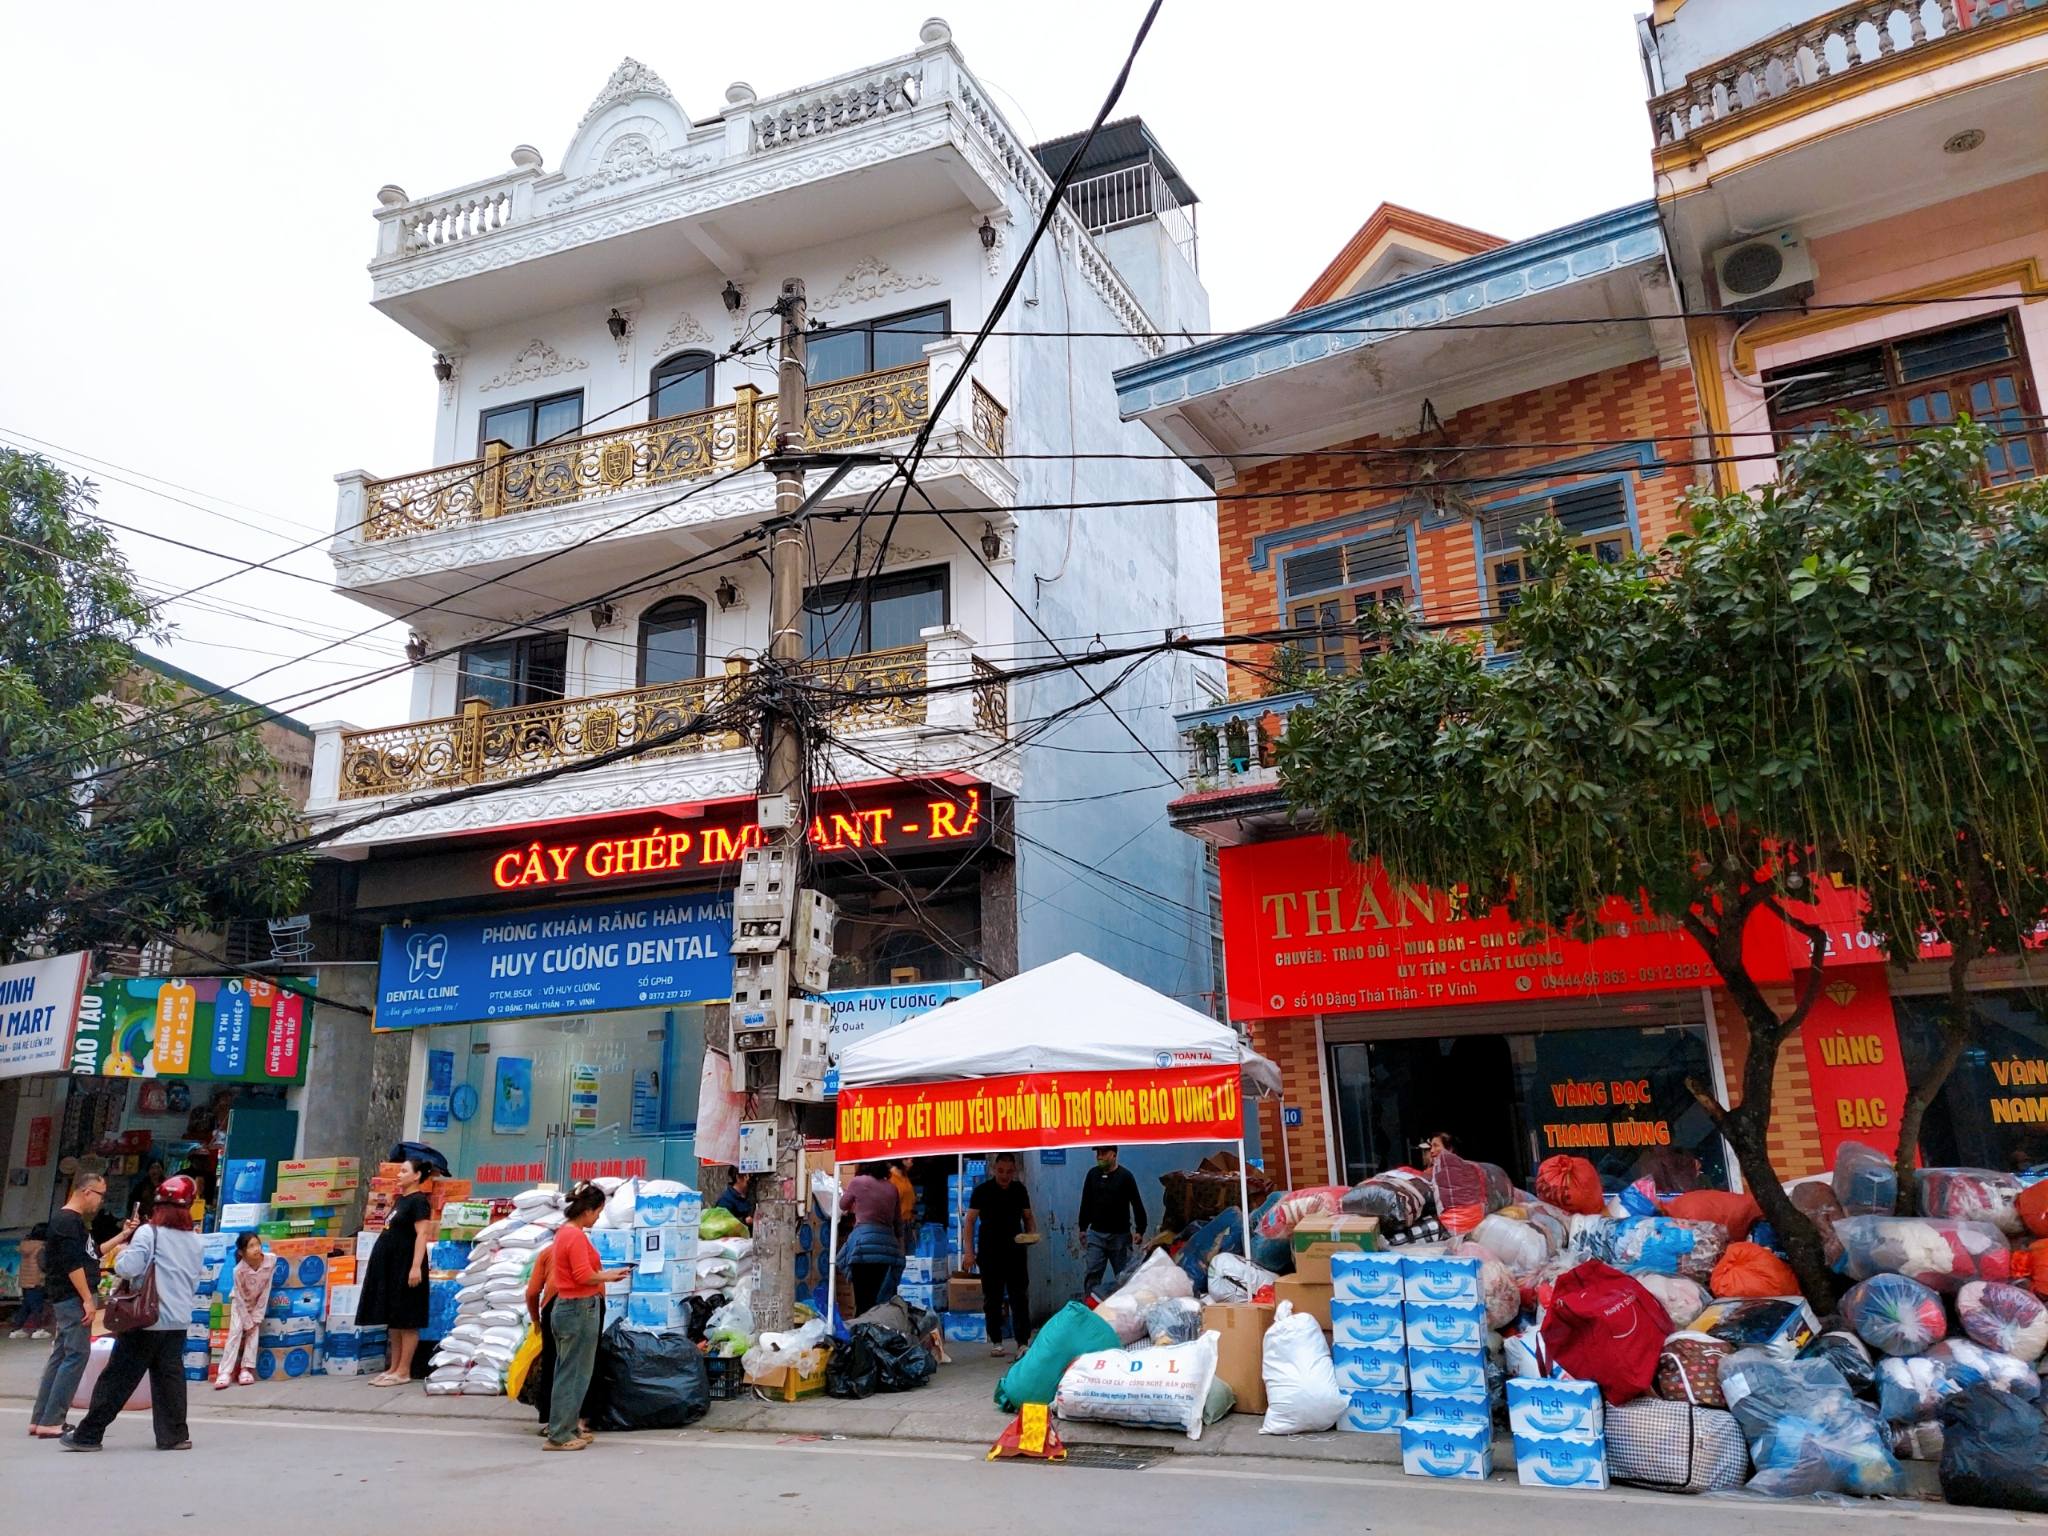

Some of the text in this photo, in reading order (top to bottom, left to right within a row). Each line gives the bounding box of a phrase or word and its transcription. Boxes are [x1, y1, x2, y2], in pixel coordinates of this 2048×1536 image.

[493, 841, 578, 889] CÂY
[585, 825, 691, 878] GHÉP
[482, 921, 536, 944] PHÒNG
[542, 914, 592, 938] KHÁM
[599, 910, 646, 932] RĂNG
[653, 904, 692, 926] HÀM
[1262, 881, 1493, 939] THAN
[490, 934, 718, 979] HUY CƯƠNG DENTAL
[1333, 946, 1364, 962] TRAO
[1368, 938, 1390, 958] ĐỔI
[1405, 940, 1435, 955] MUA
[1438, 934, 1465, 953] BÁN
[1480, 934, 1503, 948] GIA
[638, 974, 649, 987] SỐ
[1398, 965, 1416, 978] UY
[1420, 959, 1447, 975] TÍN
[1460, 952, 1502, 972] CHẤT
[1506, 951, 1563, 970] LƯỢNG
[1639, 966, 1673, 982] 0912
[1676, 963, 1699, 978] 829
[386, 985, 460, 1003] DENTAL CLINIC
[556, 983, 571, 995] HUY
[859, 998, 887, 1012] HUY
[890, 993, 937, 1009] CƯƠNG
[1294, 991, 1308, 1007] số
[1310, 993, 1323, 1006] 10
[1326, 991, 1356, 1009] Đặng
[1359, 987, 1385, 1002] Thái
[1387, 985, 1417, 1001] Thân
[1427, 984, 1443, 997] TP
[1448, 981, 1477, 995] Vinh
[6, 1005, 56, 1037] MART
[77, 995, 106, 1032] TẠO
[156, 997, 174, 1061] TIẾNG ANH
[842, 1020, 864, 1032] Quát
[216, 1013, 229, 1052] ÔN THI
[226, 1000, 244, 1068] TỐT NGHIỆP
[271, 1000, 285, 1072] LUYỆN TIẾNG ANH
[284, 1017, 296, 1057] GIAO TIẾP
[1819, 1028, 1884, 1066] VÀNG
[171, 1041, 184, 1064] CẤP
[1991, 1054, 2048, 1086] VÀN
[1551, 1078, 1651, 1110] VÀNG BẠC
[841, 1078, 1236, 1148] ĐIỂM TẬP KẾT NHU YẾU PHẨM HỖ TRỢ ĐỒNG BÀO VÙNG LŨ
[1284, 1110, 1298, 1123] 10
[1837, 1097, 1888, 1134] BẠC
[1544, 1117, 1671, 1148] THANH HÙNG
[477, 1160, 545, 1184] RĂNG HÀM MẶ
[570, 1156, 647, 1180] RĂNG HÀM MẶT
[1094, 1360, 1179, 1373] B D L
